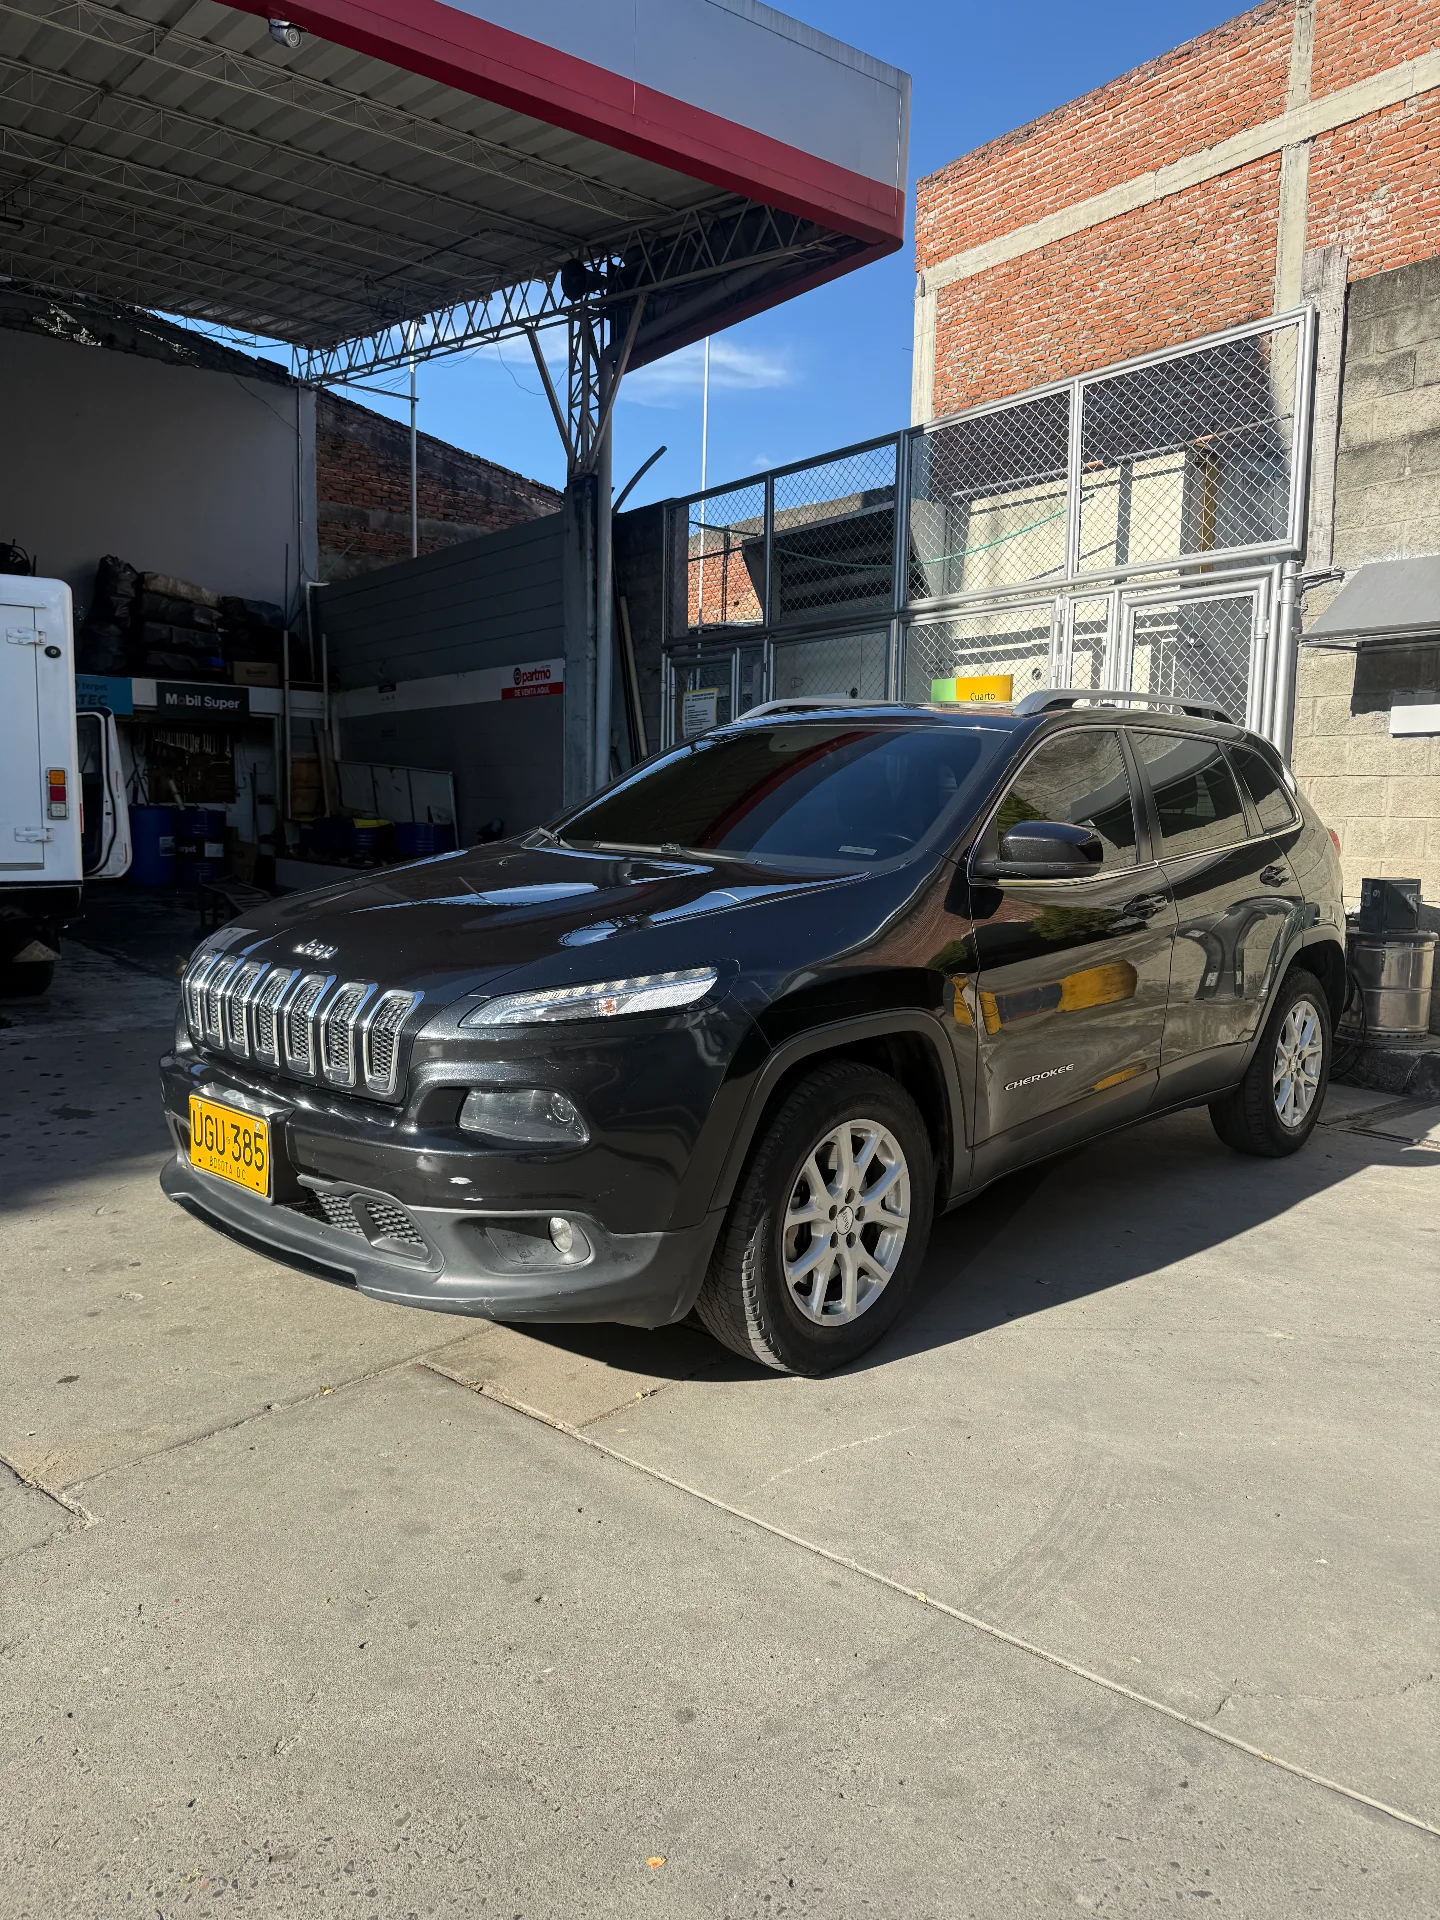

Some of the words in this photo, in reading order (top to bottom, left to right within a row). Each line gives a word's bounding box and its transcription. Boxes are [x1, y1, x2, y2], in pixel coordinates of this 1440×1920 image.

[522, 668, 551, 685] partmo
[81, 682, 108, 691] terpel
[514, 689, 521, 697] DE
[521, 687, 536, 696] VENTA
[165, 693, 201, 707] Mobil
[204, 696, 240, 711] Super
[969, 692, 996, 702] Cuarto
[293, 939, 339, 960] Jeep
[1004, 1063, 1075, 1091] CHEROKEE
[193, 1110, 226, 1156] UGU
[230, 1122, 265, 1172] 385
